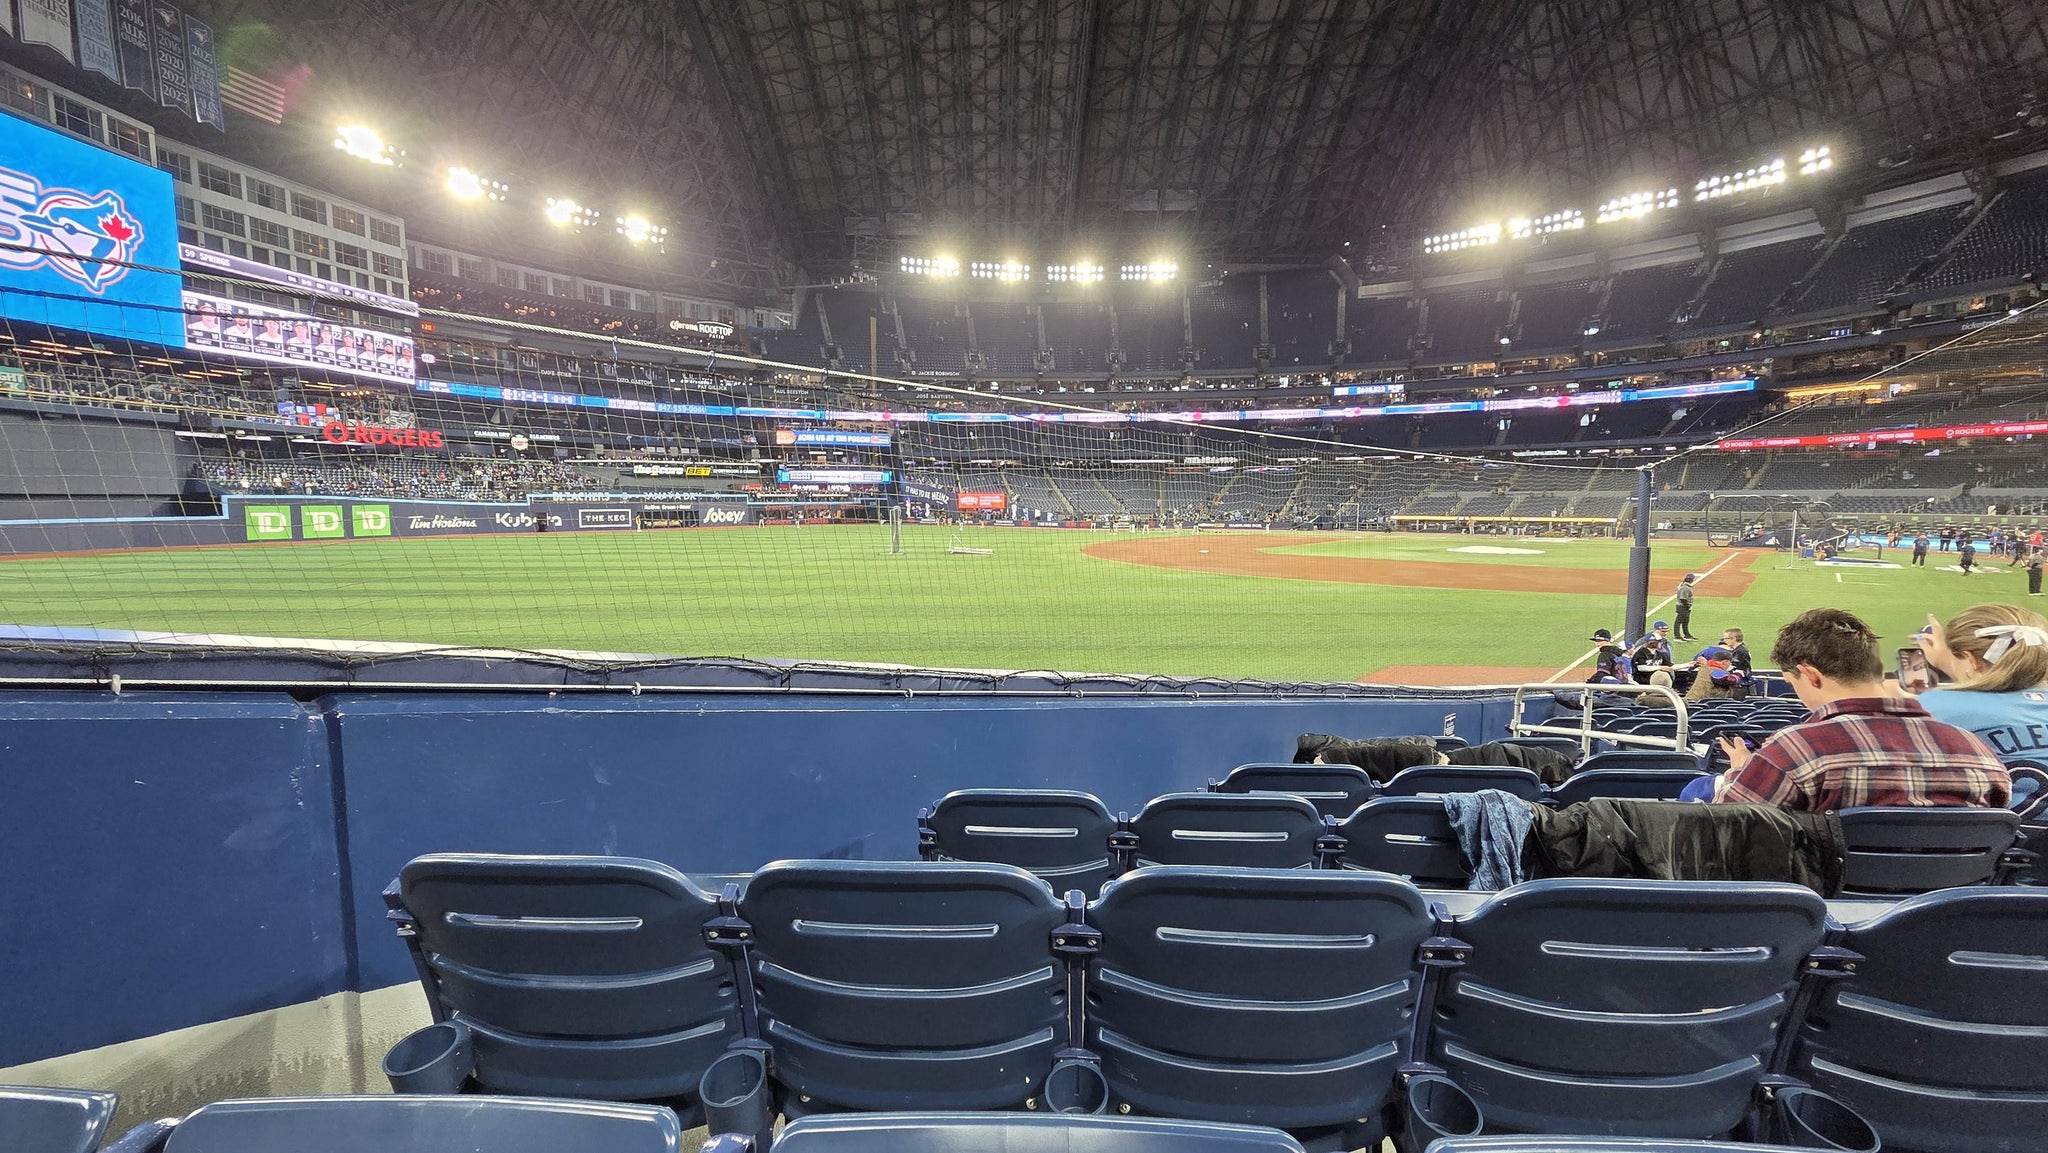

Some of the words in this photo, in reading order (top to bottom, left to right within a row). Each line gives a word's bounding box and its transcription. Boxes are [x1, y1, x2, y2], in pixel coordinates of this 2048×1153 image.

[120, 5, 144, 27] 2016
[121, 21, 147, 42] ALDS
[159, 34, 181, 53] 2016
[159, 50, 184, 71] 2020
[192, 45, 213, 64] 2025
[161, 67, 186, 88] 2022
[163, 85, 188, 104] 2023
[282, 321, 293, 331] 25
[669, 320, 699, 331] Corona
[699, 324, 734, 336] ROOFTOP
[355, 424, 444, 449] ROGERS
[797, 434, 815, 442] JOIN
[815, 434, 826, 442] US
[826, 434, 836, 442] AT
[633, 464, 684, 475] theScore
[552, 491, 610, 502] BLEACHERS
[931, 491, 950, 505] HEINZ
[250, 512, 287, 533] TD
[305, 511, 340, 532] TD
[356, 511, 387, 530] TD
[408, 515, 431, 530] Tim
[431, 514, 478, 529] Hortons
[585, 514, 605, 522] THE
[608, 514, 626, 522] KEG
[703, 507, 746, 524] Sobeys
[1987, 724, 2048, 755] CLE
